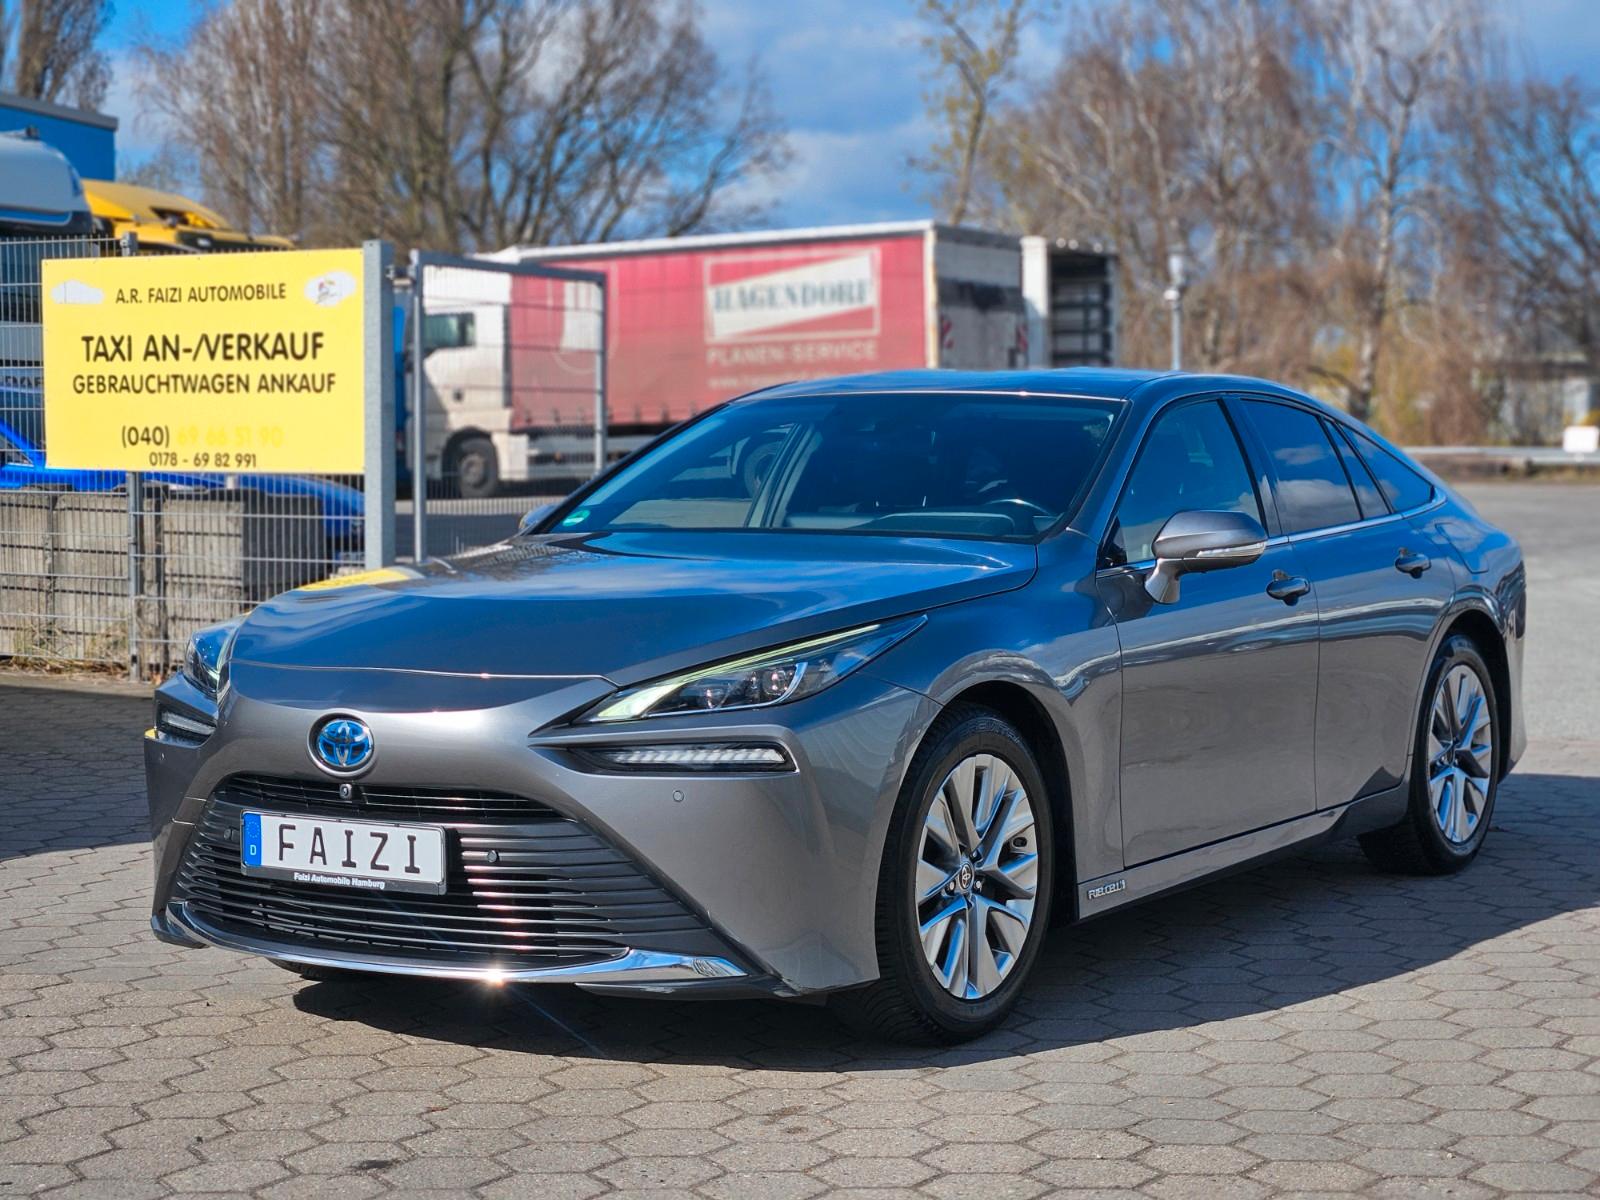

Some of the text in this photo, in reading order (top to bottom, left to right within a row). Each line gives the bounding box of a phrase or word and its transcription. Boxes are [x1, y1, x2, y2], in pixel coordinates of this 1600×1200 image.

[115, 283, 287, 304] A.R. FAIZI AUTOMOBILE
[81, 335, 133, 362] TAXI
[793, 339, 876, 362] SERVICE
[73, 373, 336, 394] GEBRAUCHTWAGEN ANKAUF
[122, 425, 170, 448] (040)
[149, 452, 178, 468] 0178
[193, 452, 210, 468] 69
[215, 453, 231, 468] 82
[235, 453, 257, 468] 991
[250, 845, 257, 856] D
[278, 824, 421, 874] FAIZI
[293, 872, 386, 890] Faizi Automobile Hamburg
